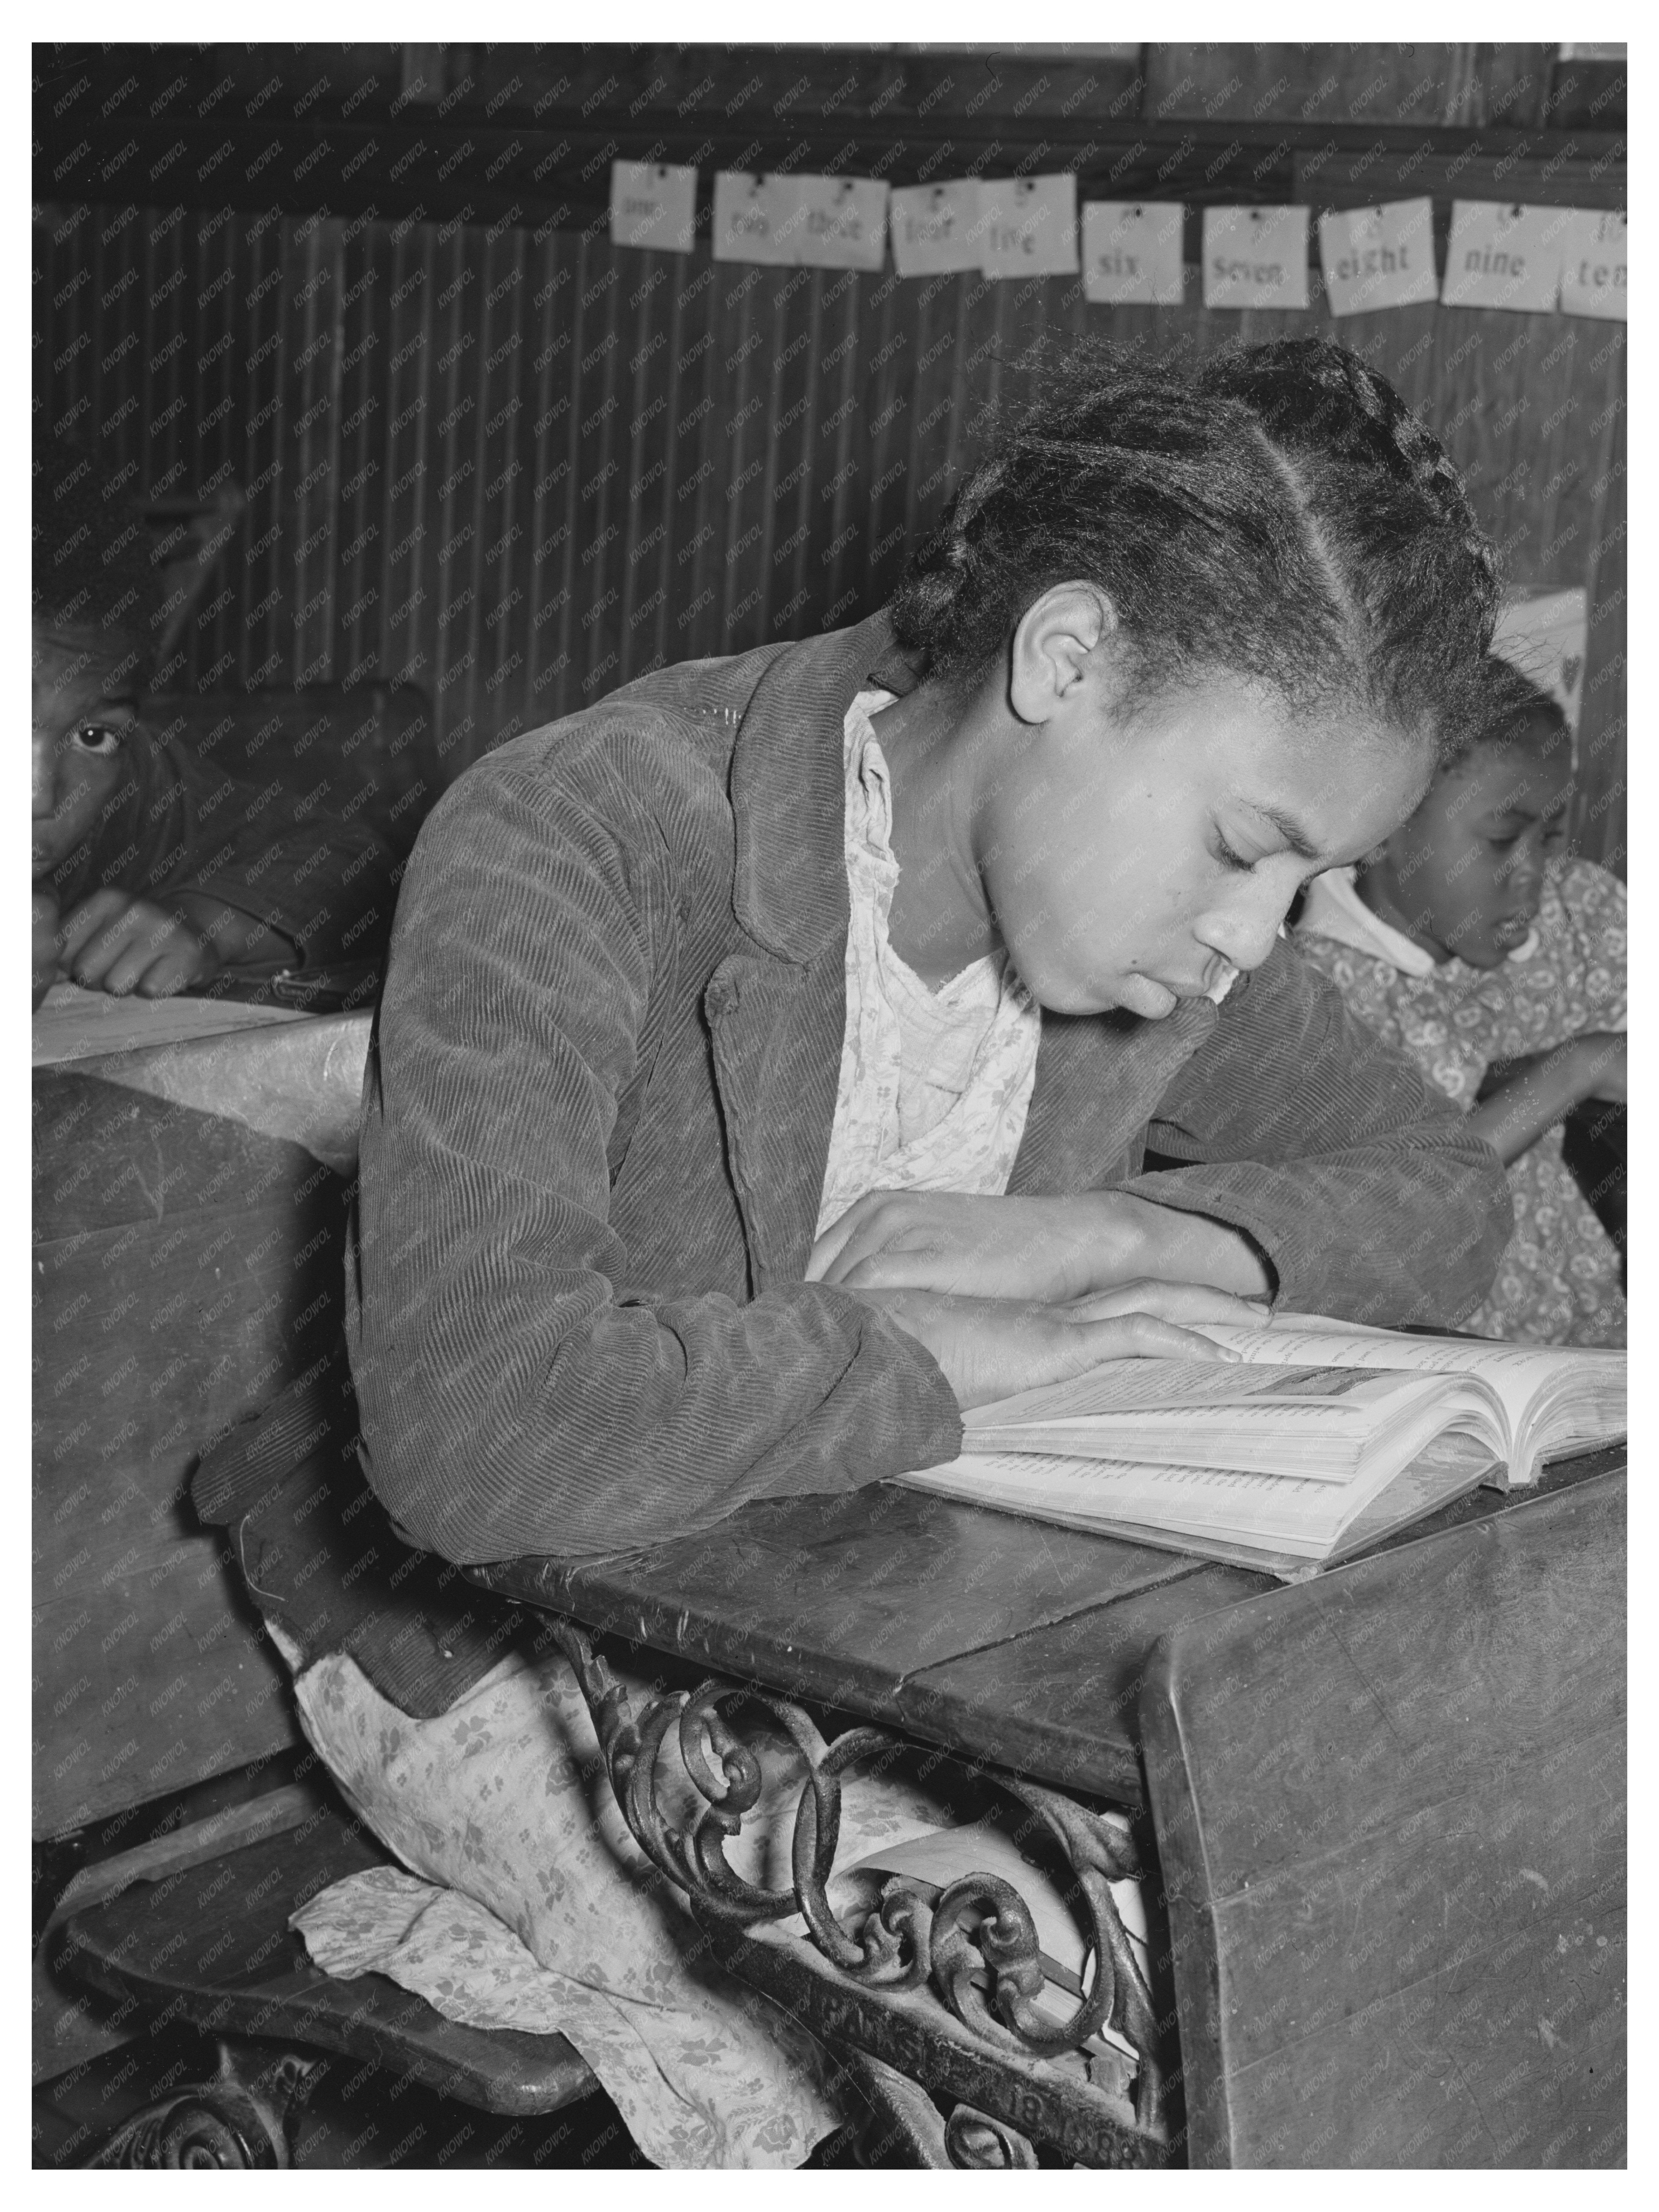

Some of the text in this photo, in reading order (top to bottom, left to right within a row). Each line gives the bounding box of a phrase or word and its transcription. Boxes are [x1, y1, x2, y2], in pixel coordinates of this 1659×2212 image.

[1098, 247, 1139, 277] six
[1212, 256, 1282, 287] seven
[1336, 244, 1409, 281] eight
[1464, 244, 1526, 278] nine
[1578, 259, 1627, 287] ten
[1331, 1352, 1346, 1362] than
[1164, 1474, 1179, 1482] had
[1177, 1471, 1198, 1482] When
[1228, 1478, 1243, 1487] died
